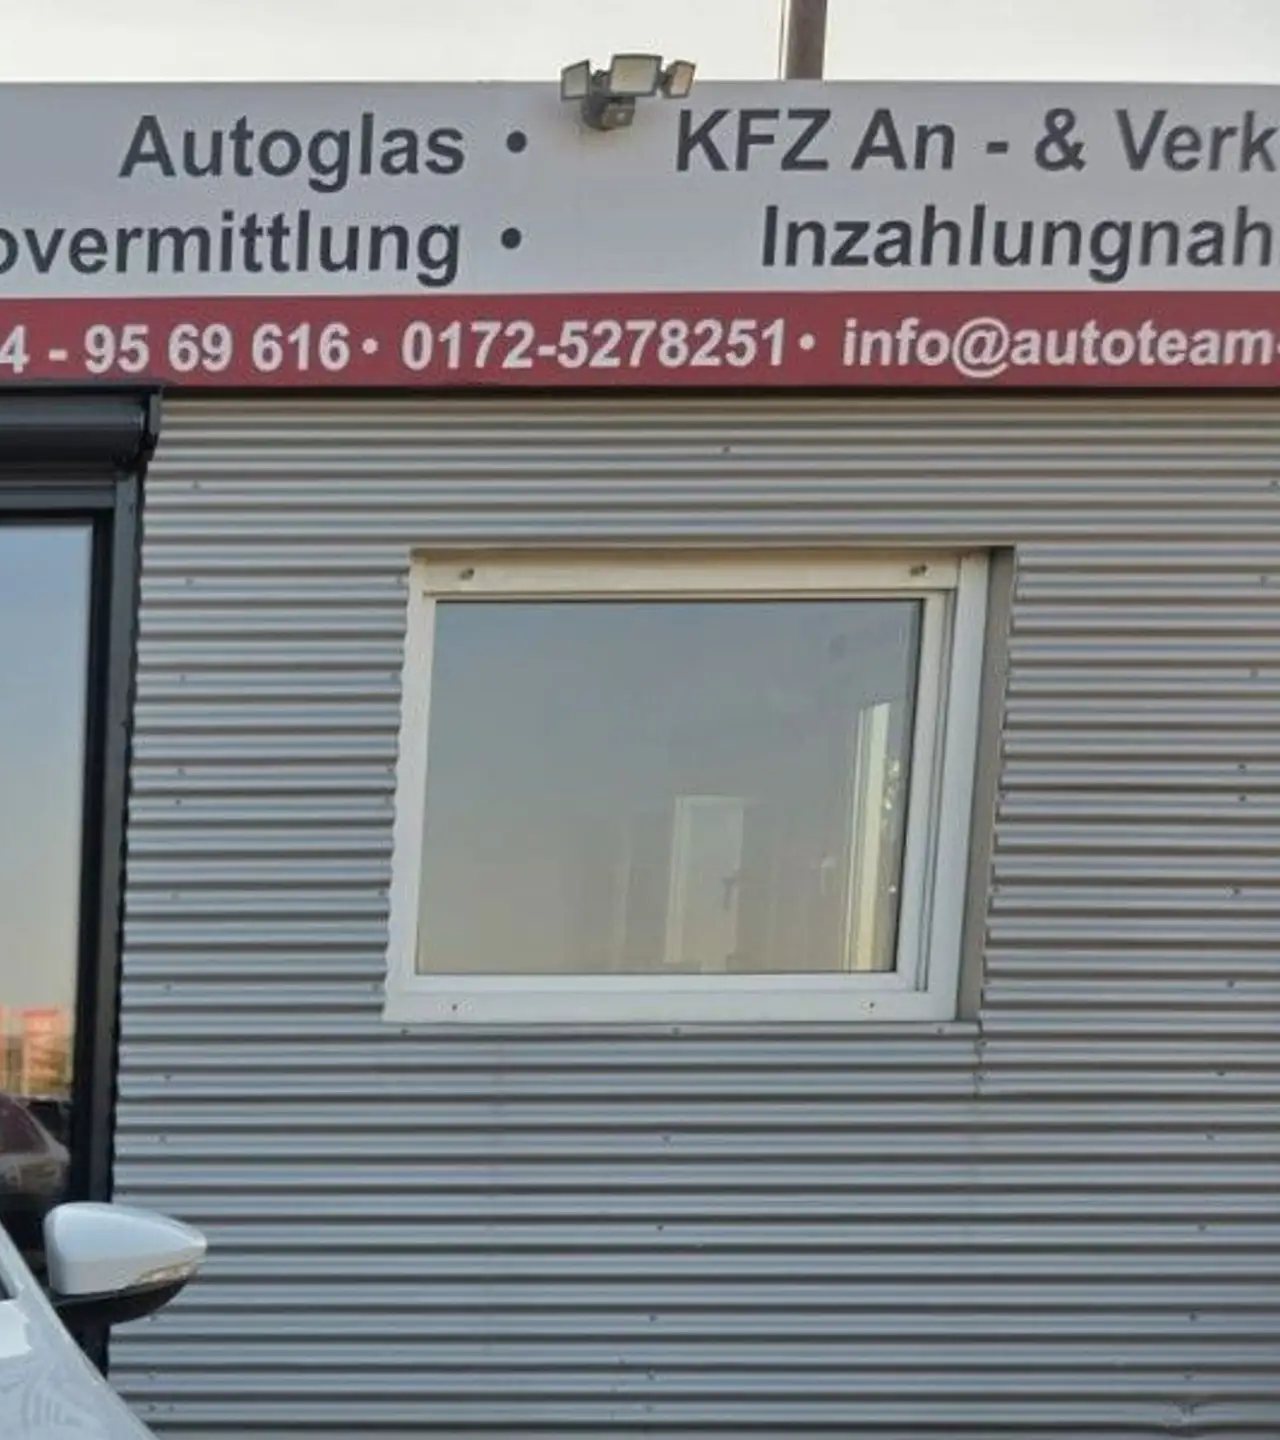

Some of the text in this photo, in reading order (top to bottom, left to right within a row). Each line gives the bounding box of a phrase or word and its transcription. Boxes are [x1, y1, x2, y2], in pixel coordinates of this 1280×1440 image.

[118, 112, 465, 194] Autoglas
[676, 108, 832, 172] KFZ
[850, 107, 955, 171] An
[1034, 107, 1086, 172] &
[1115, 108, 1280, 172] Verk
[762, 203, 1274, 284] Inzahlungnah
[84, 324, 150, 374] 95
[168, 323, 233, 372] 69
[843, 317, 1280, 378] info@autoteam
